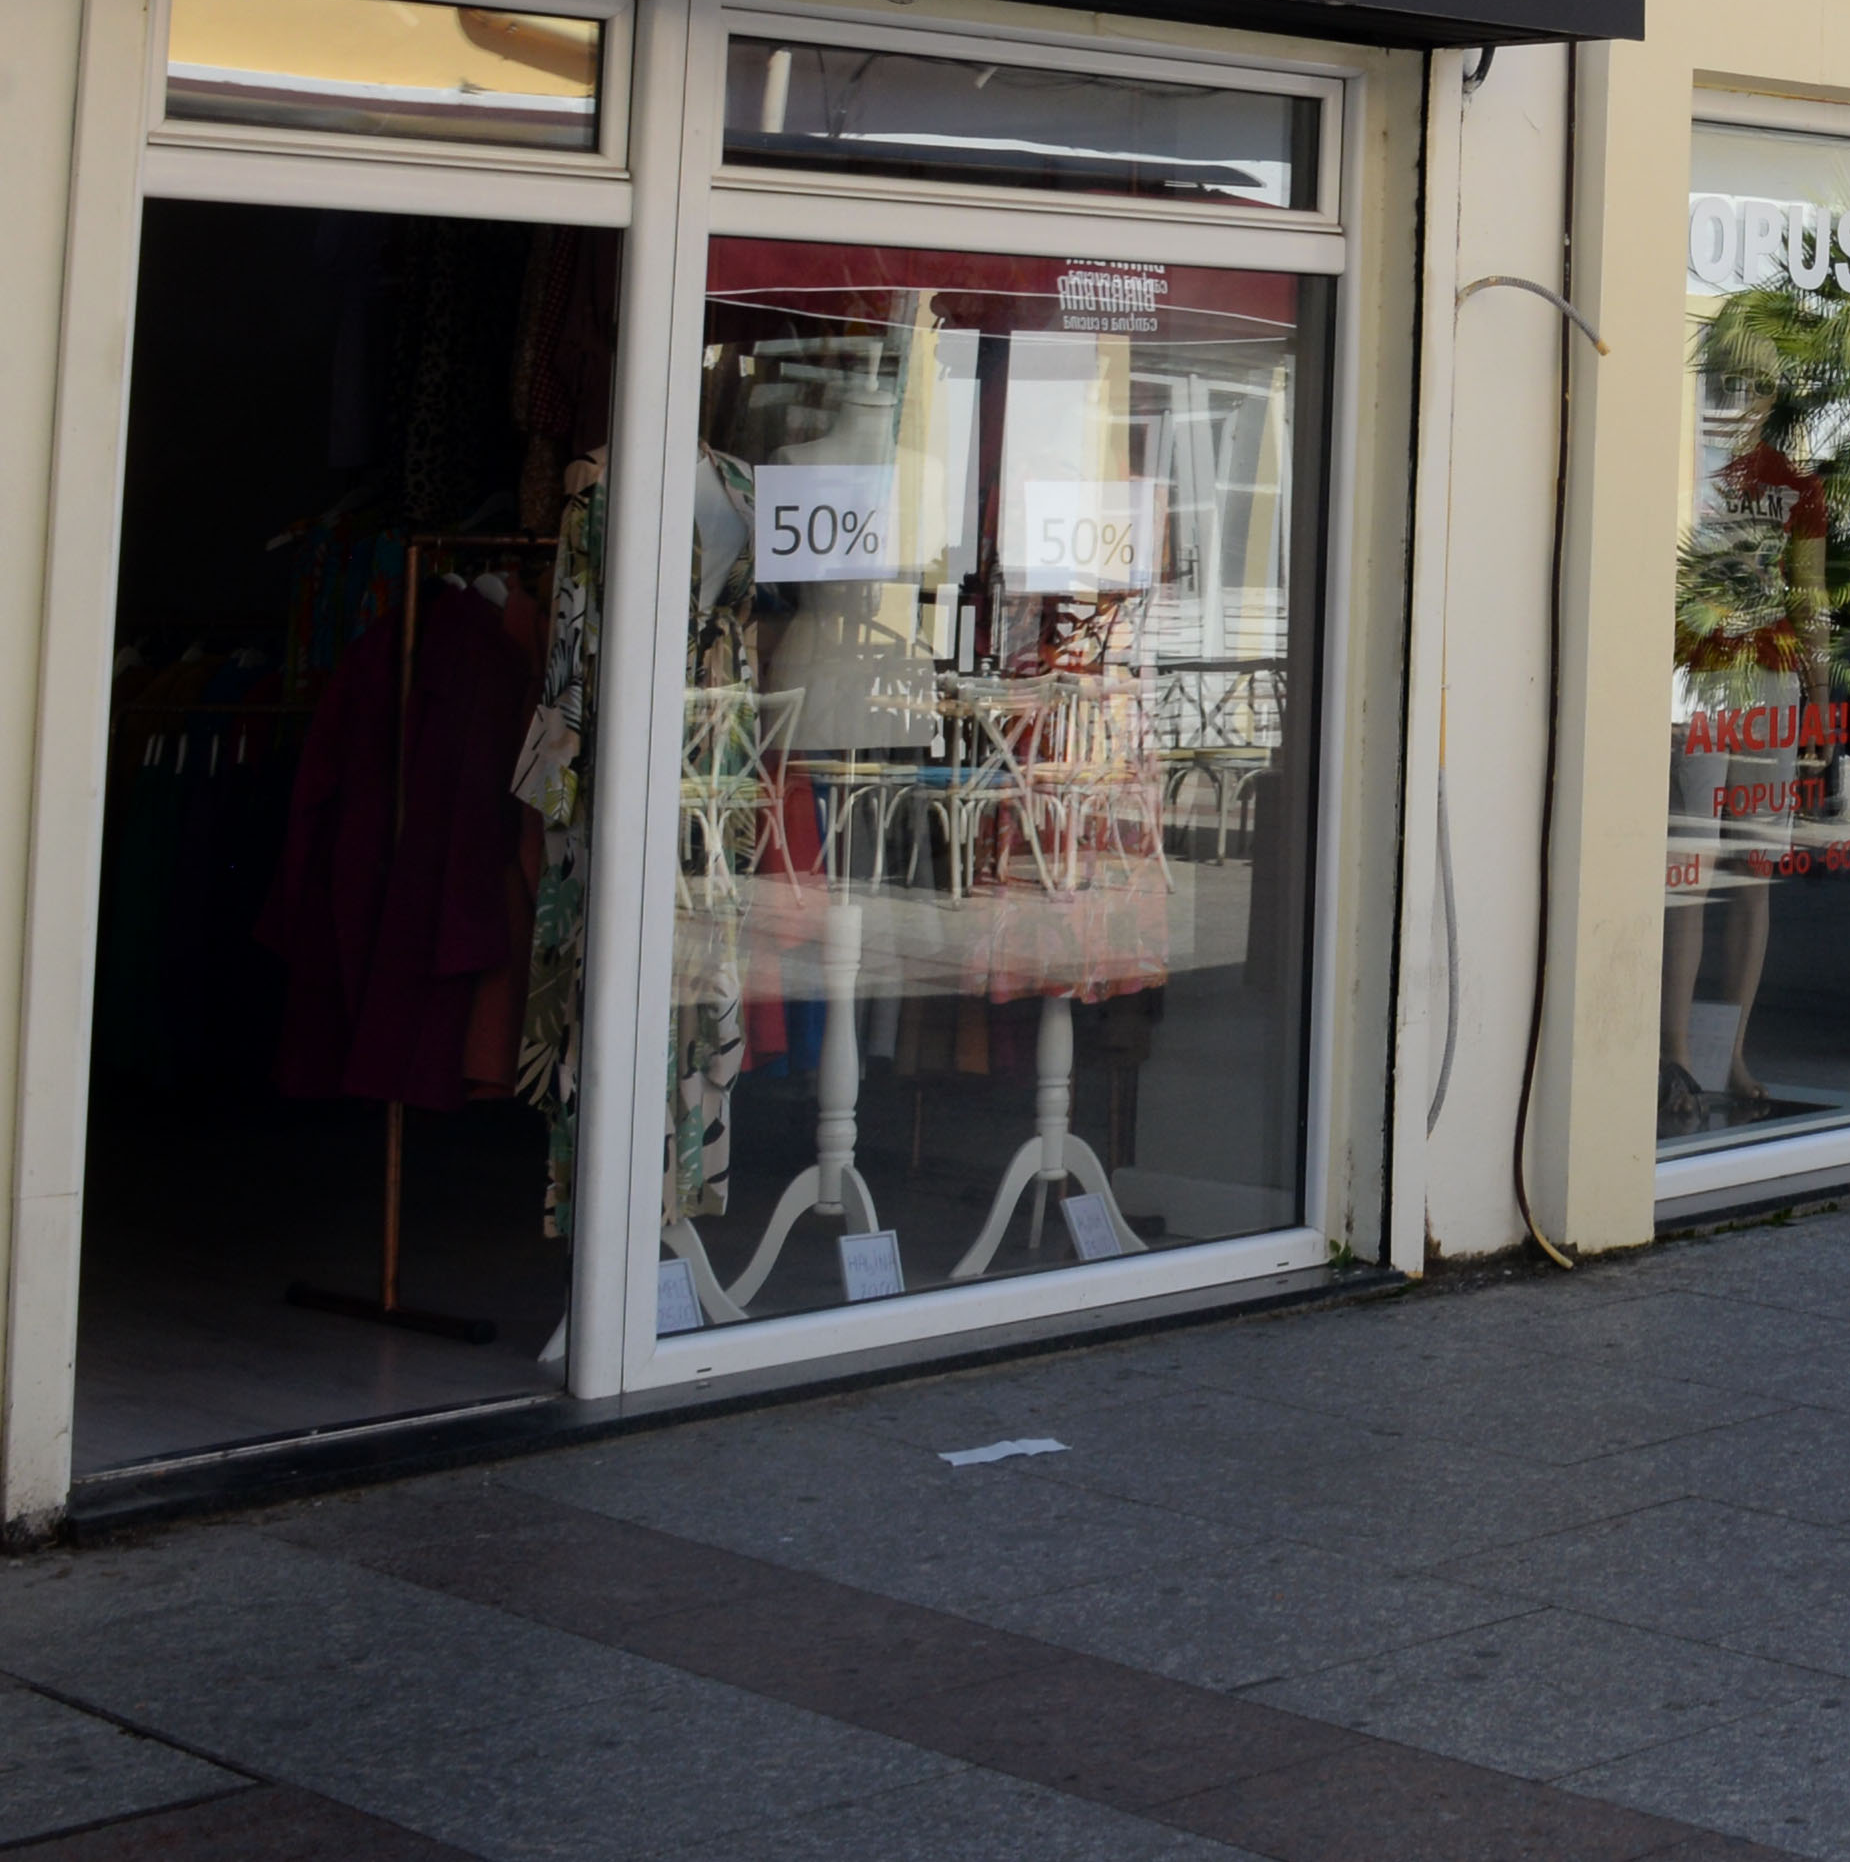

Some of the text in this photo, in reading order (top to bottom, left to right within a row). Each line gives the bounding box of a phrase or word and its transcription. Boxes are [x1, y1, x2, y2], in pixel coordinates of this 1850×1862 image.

[1727, 490, 1783, 521] CALM
[770, 503, 880, 557] 50%
[1040, 516, 1136, 567] 50%
[1713, 778, 1825, 818] POPUSTI
[1666, 853, 1699, 888] od
[1747, 848, 1773, 878] %
[1778, 842, 1812, 876] do
